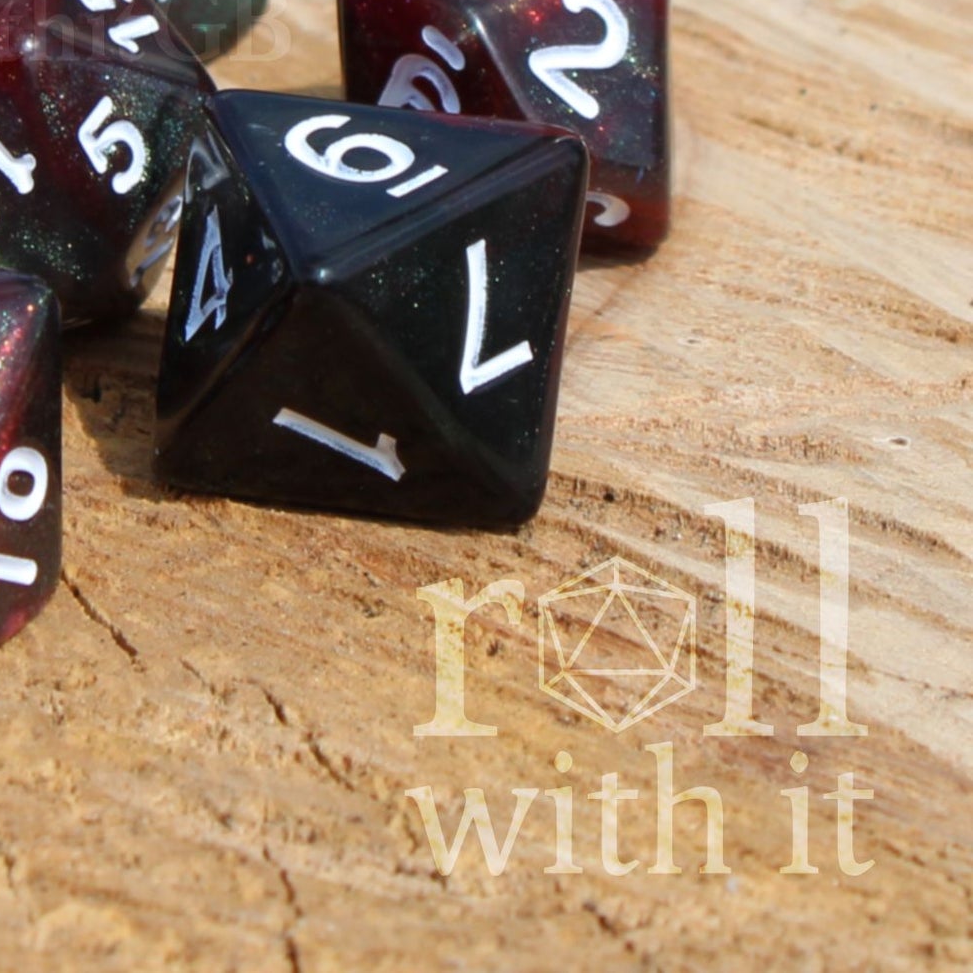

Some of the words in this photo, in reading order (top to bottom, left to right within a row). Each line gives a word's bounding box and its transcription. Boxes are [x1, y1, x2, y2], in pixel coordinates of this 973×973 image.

[78, 97, 146, 194] 5
[185, 205, 234, 341] 4
[460, 238, 533, 394] 7
[273, 407, 405, 482] 1
